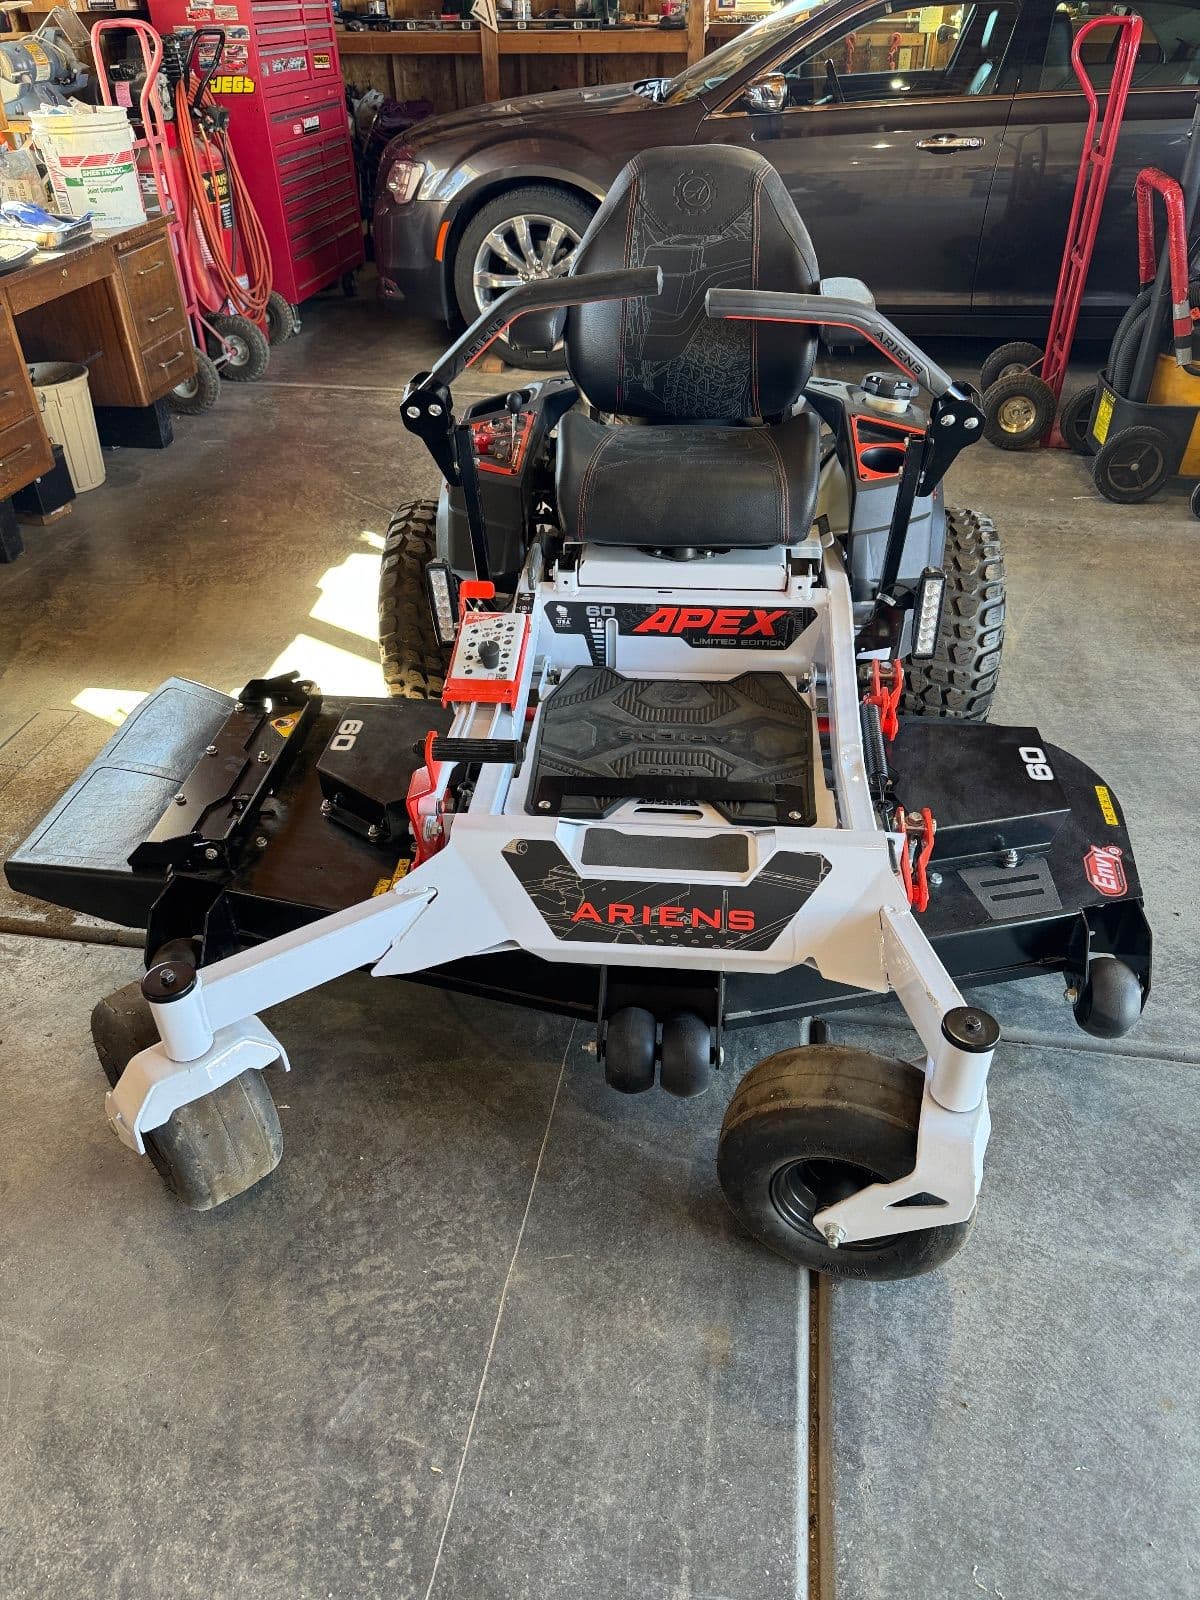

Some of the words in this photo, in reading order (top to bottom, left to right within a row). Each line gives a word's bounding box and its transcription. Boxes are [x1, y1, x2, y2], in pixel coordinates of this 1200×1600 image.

[209, 76, 255, 94] JEGS
[463, 318, 506, 361] ARIENS
[873, 331, 923, 375] ARIENS
[586, 605, 616, 617] 60
[632, 607, 788, 636] APEX
[692, 638, 737, 646] LIMITED
[740, 639, 786, 647] EDITION
[330, 719, 364, 751] 60
[1018, 746, 1055, 781] 60
[1092, 846, 1120, 890] Envy
[570, 902, 756, 931] ARIENS
